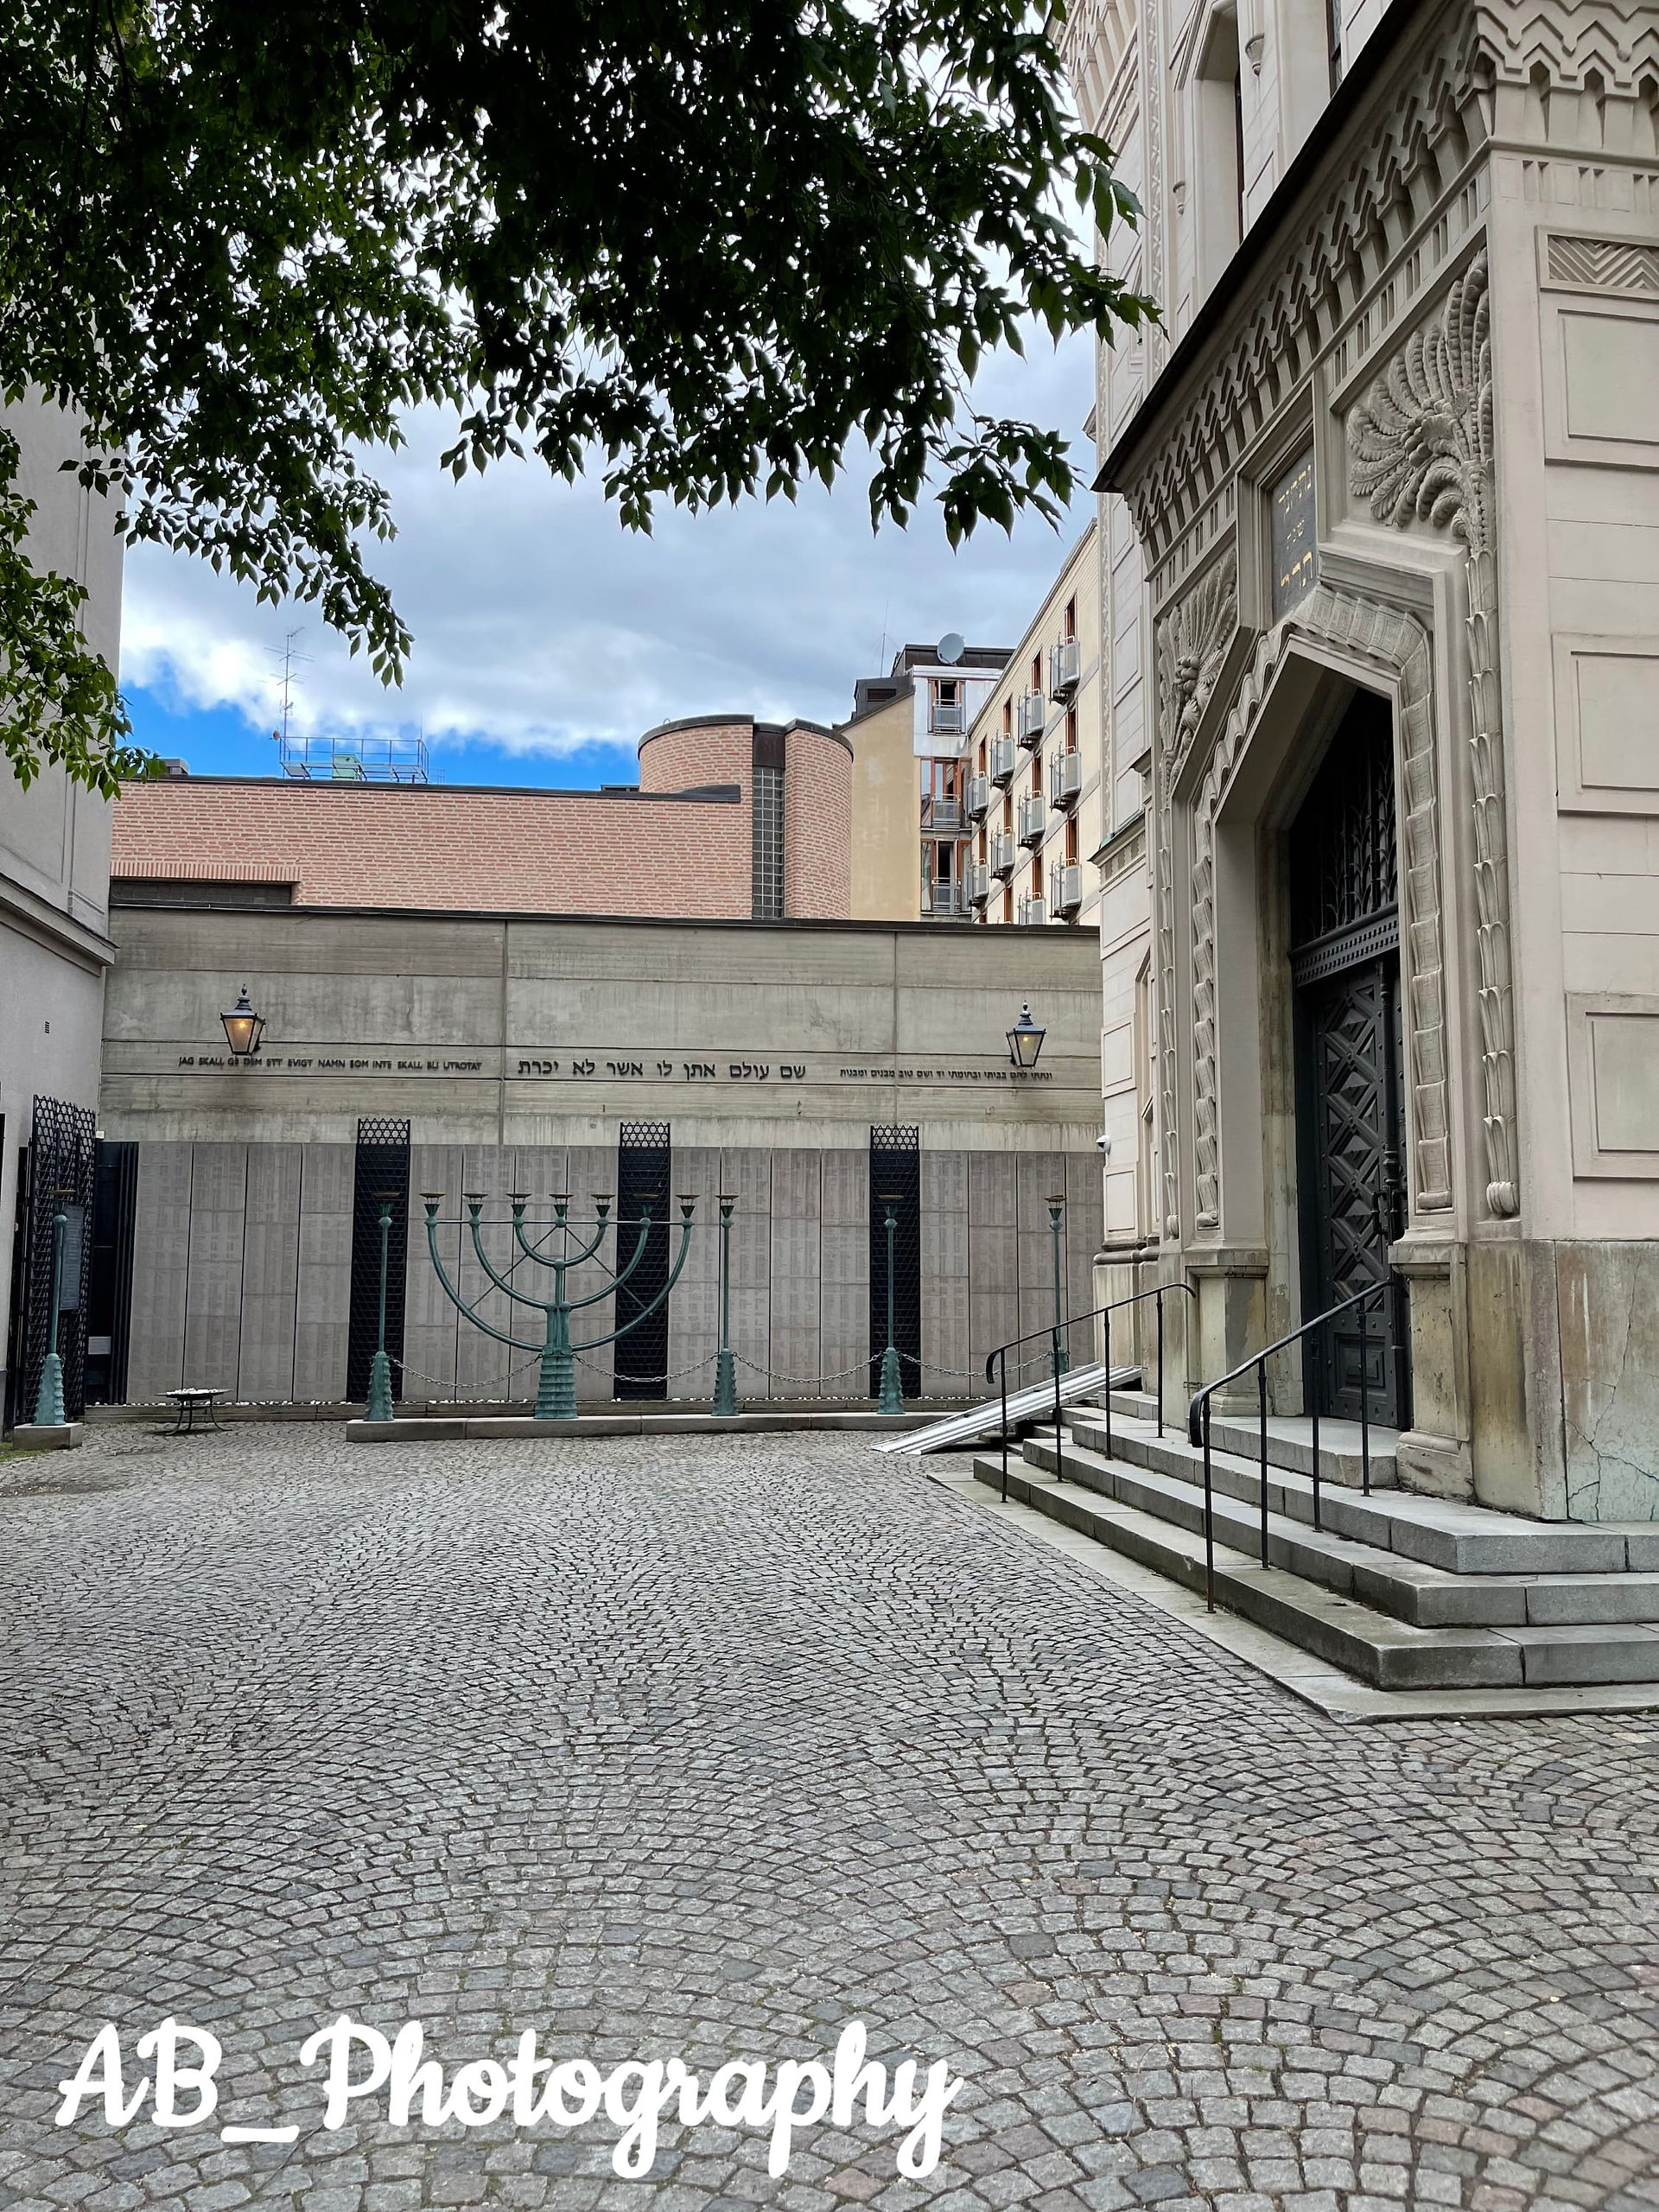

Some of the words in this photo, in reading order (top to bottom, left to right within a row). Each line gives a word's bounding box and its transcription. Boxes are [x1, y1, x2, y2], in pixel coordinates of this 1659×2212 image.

[179, 1056, 194, 1068] JAG
[198, 1057, 225, 1067] SKALL
[243, 1058, 262, 1067] DEM
[266, 1058, 283, 1068] ETT
[288, 1058, 313, 1068] EVIGT
[318, 1058, 346, 1069] NAMN
[350, 1059, 369, 1069] SOM
[372, 1060, 391, 1070] INTE
[397, 1060, 422, 1070] SKALL
[427, 1060, 439, 1071] BLI
[443, 1061, 482, 1071] UTROTAT
[518, 1058, 559, 1076] יכרת
[572, 1058, 595, 1077] לא
[607, 1061, 643, 1077] אשר
[657, 1059, 673, 1077] לו
[729, 1061, 770, 1081] עולם
[683, 1062, 716, 1082] אתן
[779, 1064, 806, 1079] שם
[840, 1069, 868, 1077] ומבנות
[870, 1069, 895, 1077] מבנים
[899, 1070, 913, 1078] טוב
[916, 1070, 933, 1078] ושם
[983, 1071, 1007, 1079] בביתי
